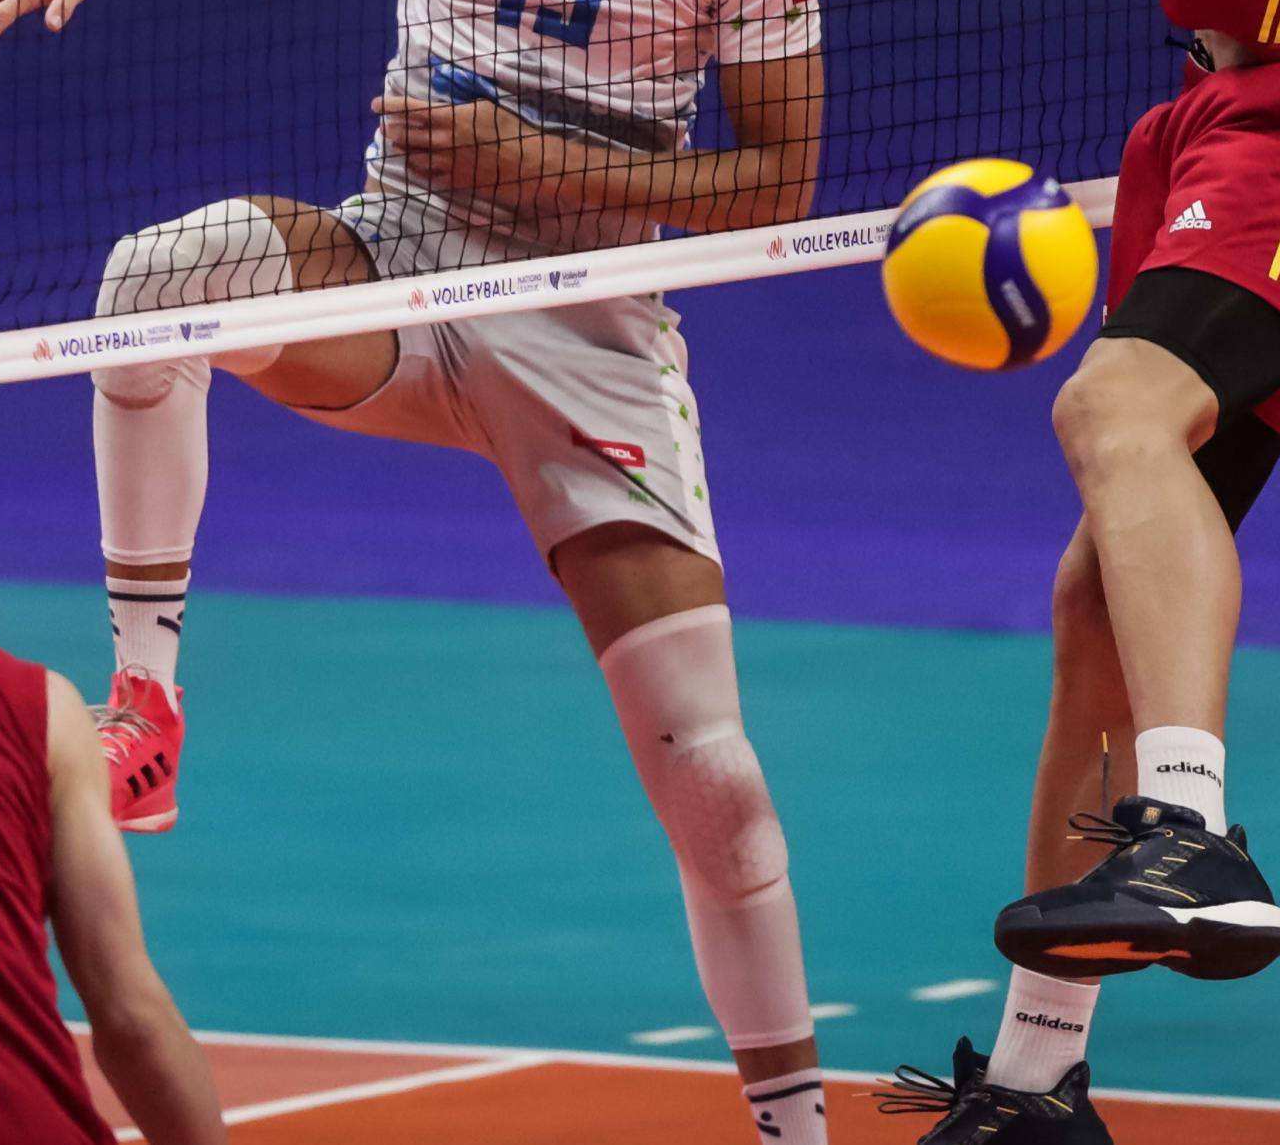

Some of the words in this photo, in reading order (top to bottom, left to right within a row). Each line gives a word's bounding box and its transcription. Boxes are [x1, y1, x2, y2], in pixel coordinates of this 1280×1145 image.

[792, 227, 875, 255] VOLLEYBALL
[432, 278, 516, 306] VOLLEYBALL
[58, 330, 147, 357] VOLLEYBALL
[1015, 1009, 1085, 1034] adidas
